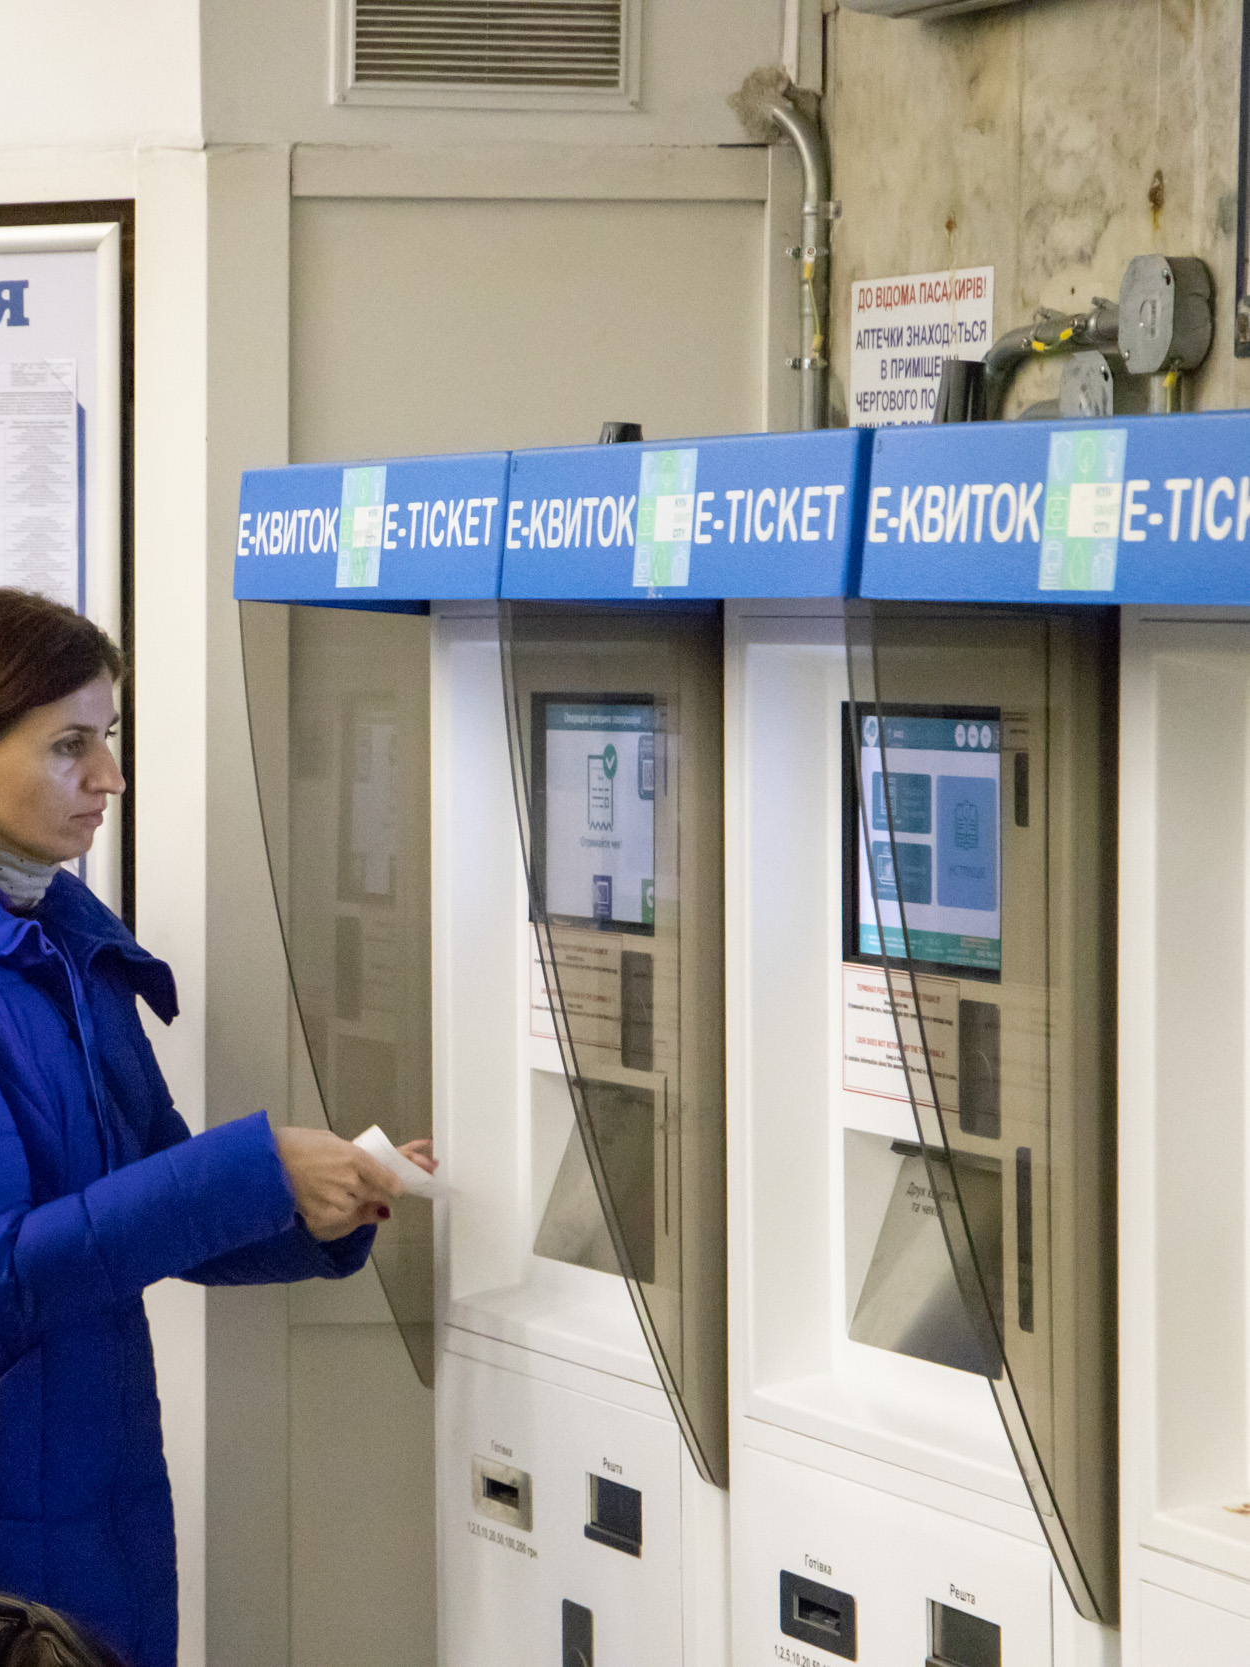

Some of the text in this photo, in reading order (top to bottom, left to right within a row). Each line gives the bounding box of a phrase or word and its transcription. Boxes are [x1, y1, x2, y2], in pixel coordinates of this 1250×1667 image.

[857, 287, 873, 312] ДО
[876, 284, 917, 311] ВІДОМА
[856, 327, 903, 350] АПТЕЧКИ
[880, 359, 888, 380] В
[856, 389, 917, 412] ЧЕРГОВОГО
[383, 497, 498, 550] E-TICKET
[506, 495, 636, 549] Е-КВИТОК
[694, 485, 845, 544] E-TICKET
[868, 482, 1043, 543] Е-КВИТОК
[237, 507, 339, 557] Е-КВИТОК
[491, 1439, 513, 1458] Готівка
[603, 1457, 623, 1475] Решта
[804, 1554, 832, 1576] Готівка
[950, 1583, 976, 1606] Решта
